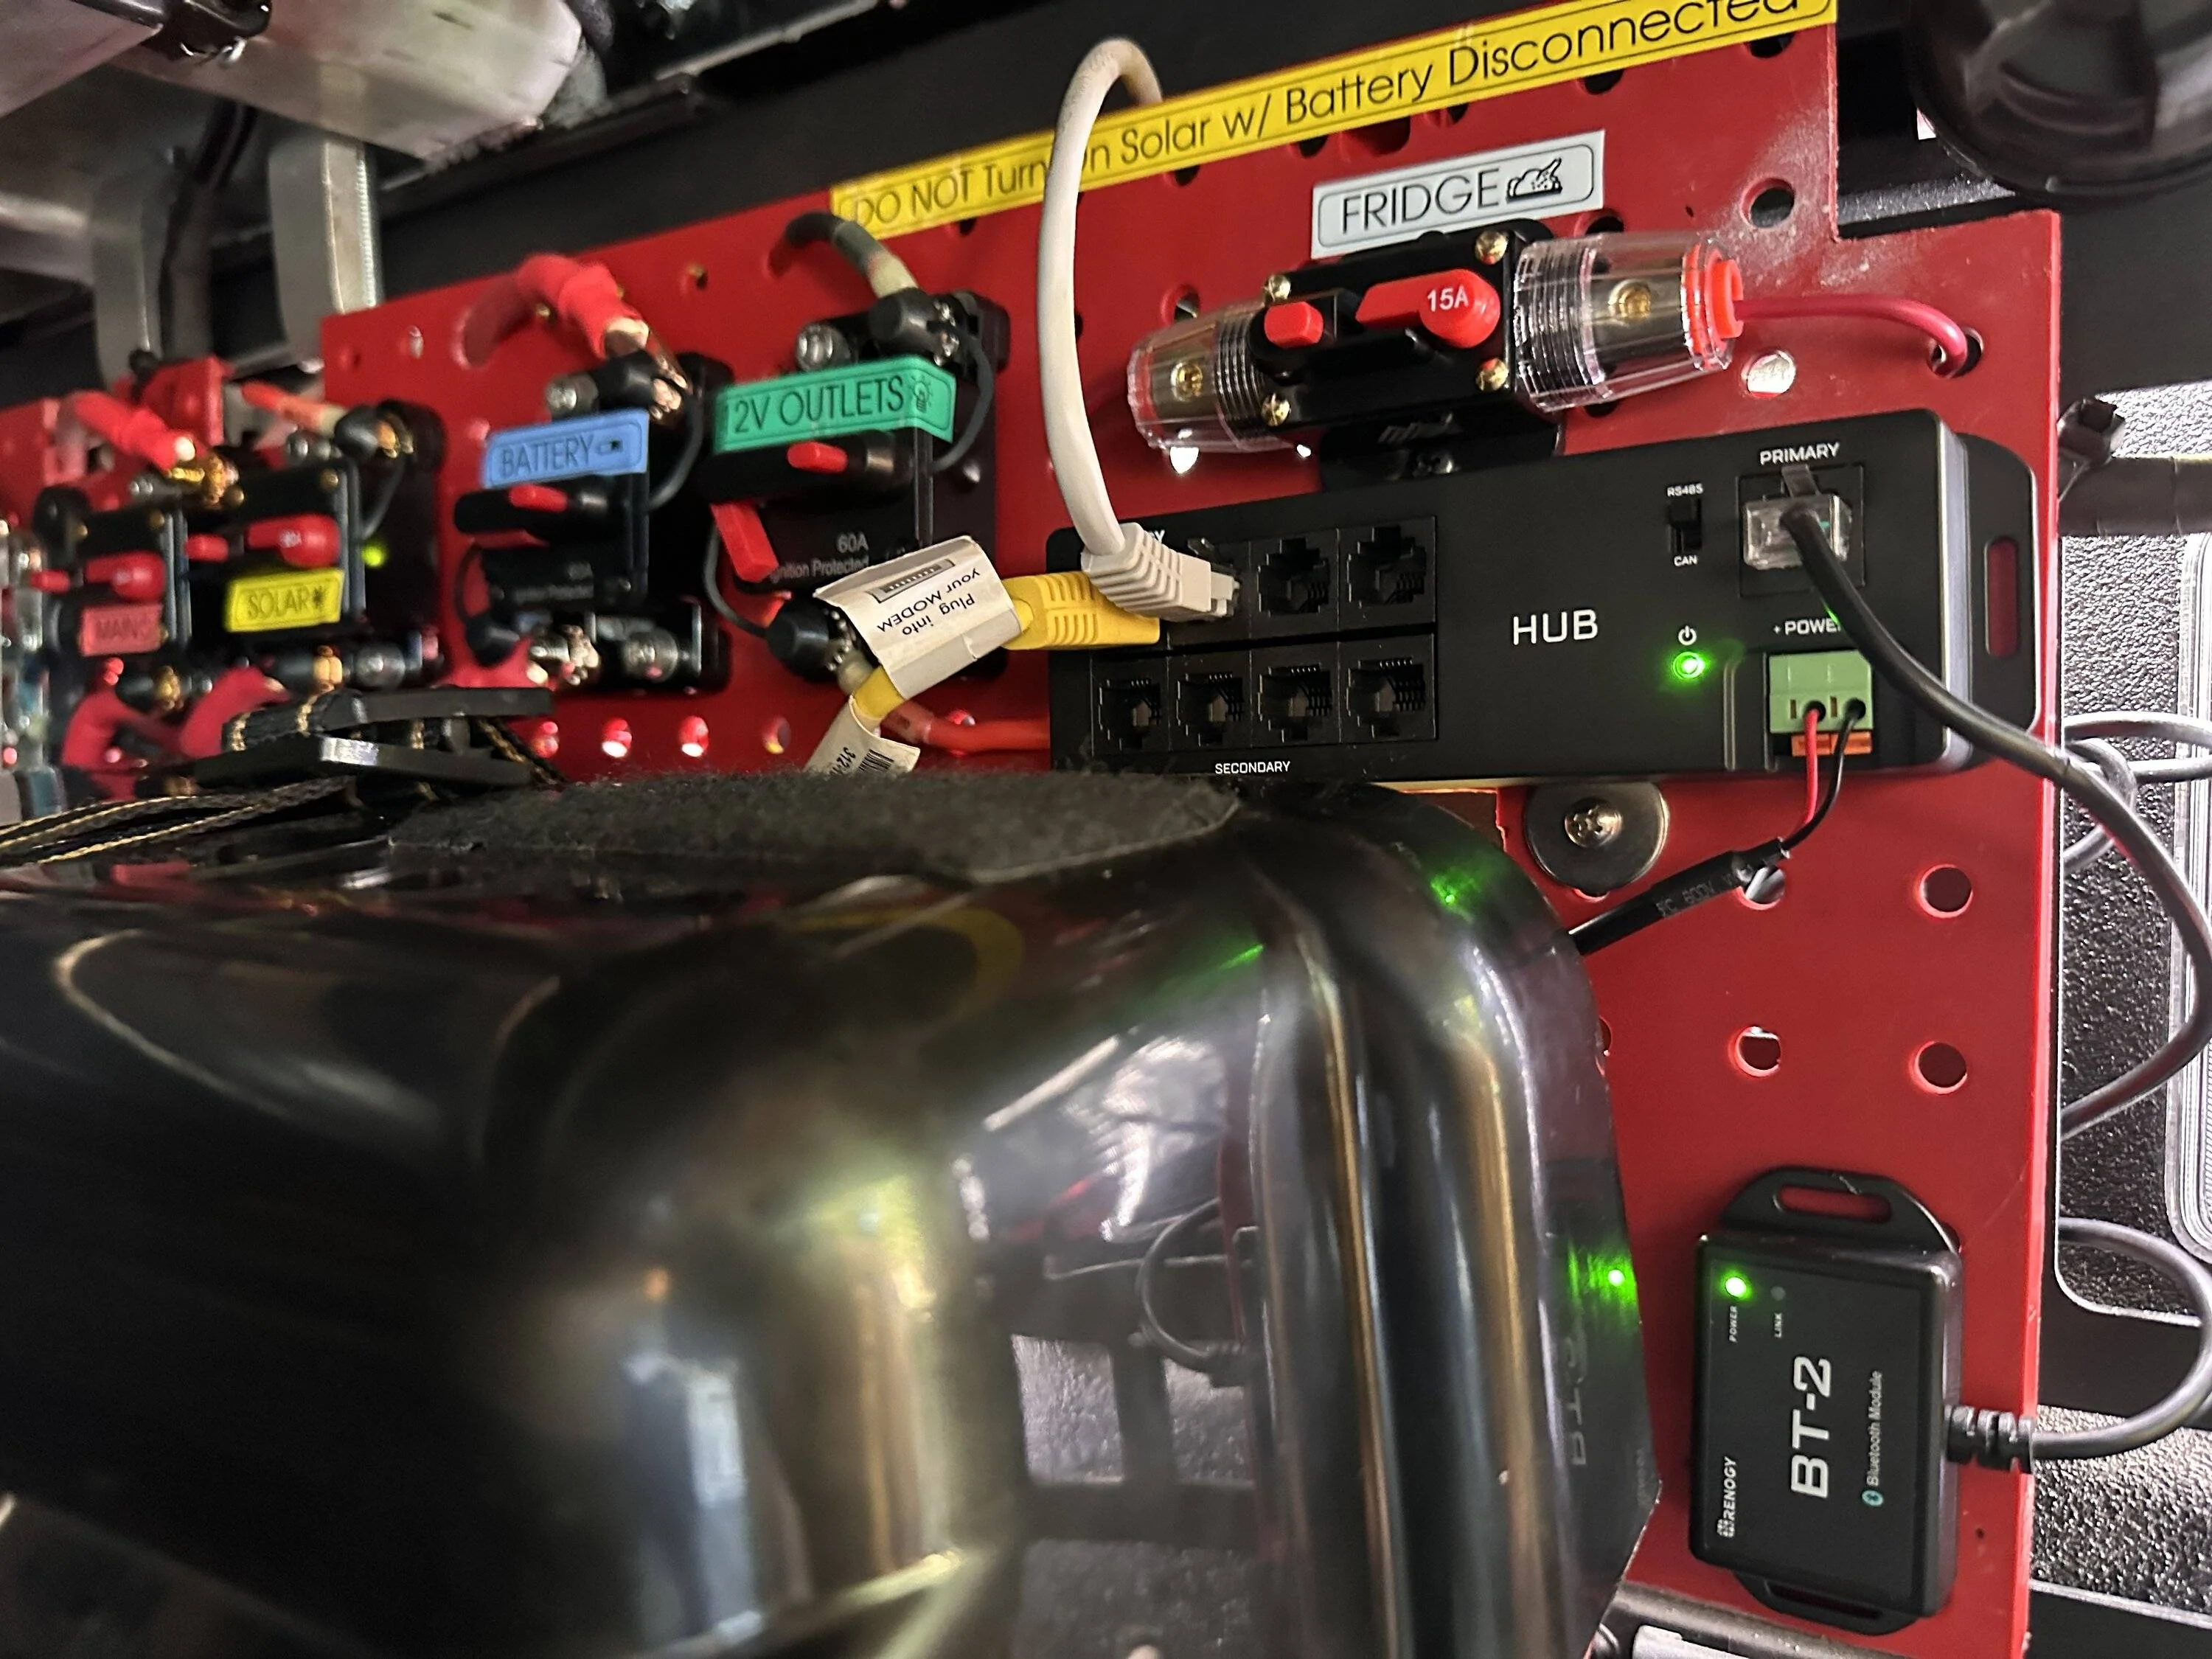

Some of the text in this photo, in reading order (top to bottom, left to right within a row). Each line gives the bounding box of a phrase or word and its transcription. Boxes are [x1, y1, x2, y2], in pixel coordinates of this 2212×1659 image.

[912, 168, 973, 215] NOT
[985, 160, 1048, 197] Turn
[1121, 118, 1211, 164] Solar
[1222, 94, 1271, 139] w/
[1287, 63, 1433, 125] Battery
[1343, 168, 1500, 234] FRIDGE
[1427, 285, 1469, 313] 15A
[780, 375, 904, 426] OUTLETS
[501, 434, 594, 479] BATTERY
[1760, 442, 1840, 465] PRIMARY
[1667, 483, 1704, 497] RS485
[836, 532, 869, 554] 60A
[1674, 555, 1697, 567] CAN
[770, 561, 809, 583] gnition
[247, 587, 311, 620] SOLAR
[877, 567, 981, 633] your MODEM
[902, 593, 975, 636] Plug into
[1513, 609, 1599, 646] HUB
[1215, 760, 1290, 774] SECONDARY
[1729, 1306, 1737, 1342] POWER
[1790, 1356, 1832, 1499] BT-2
[1866, 1370, 1882, 1486] Bluetooth Module
[1723, 1456, 1736, 1522] RENOGY
